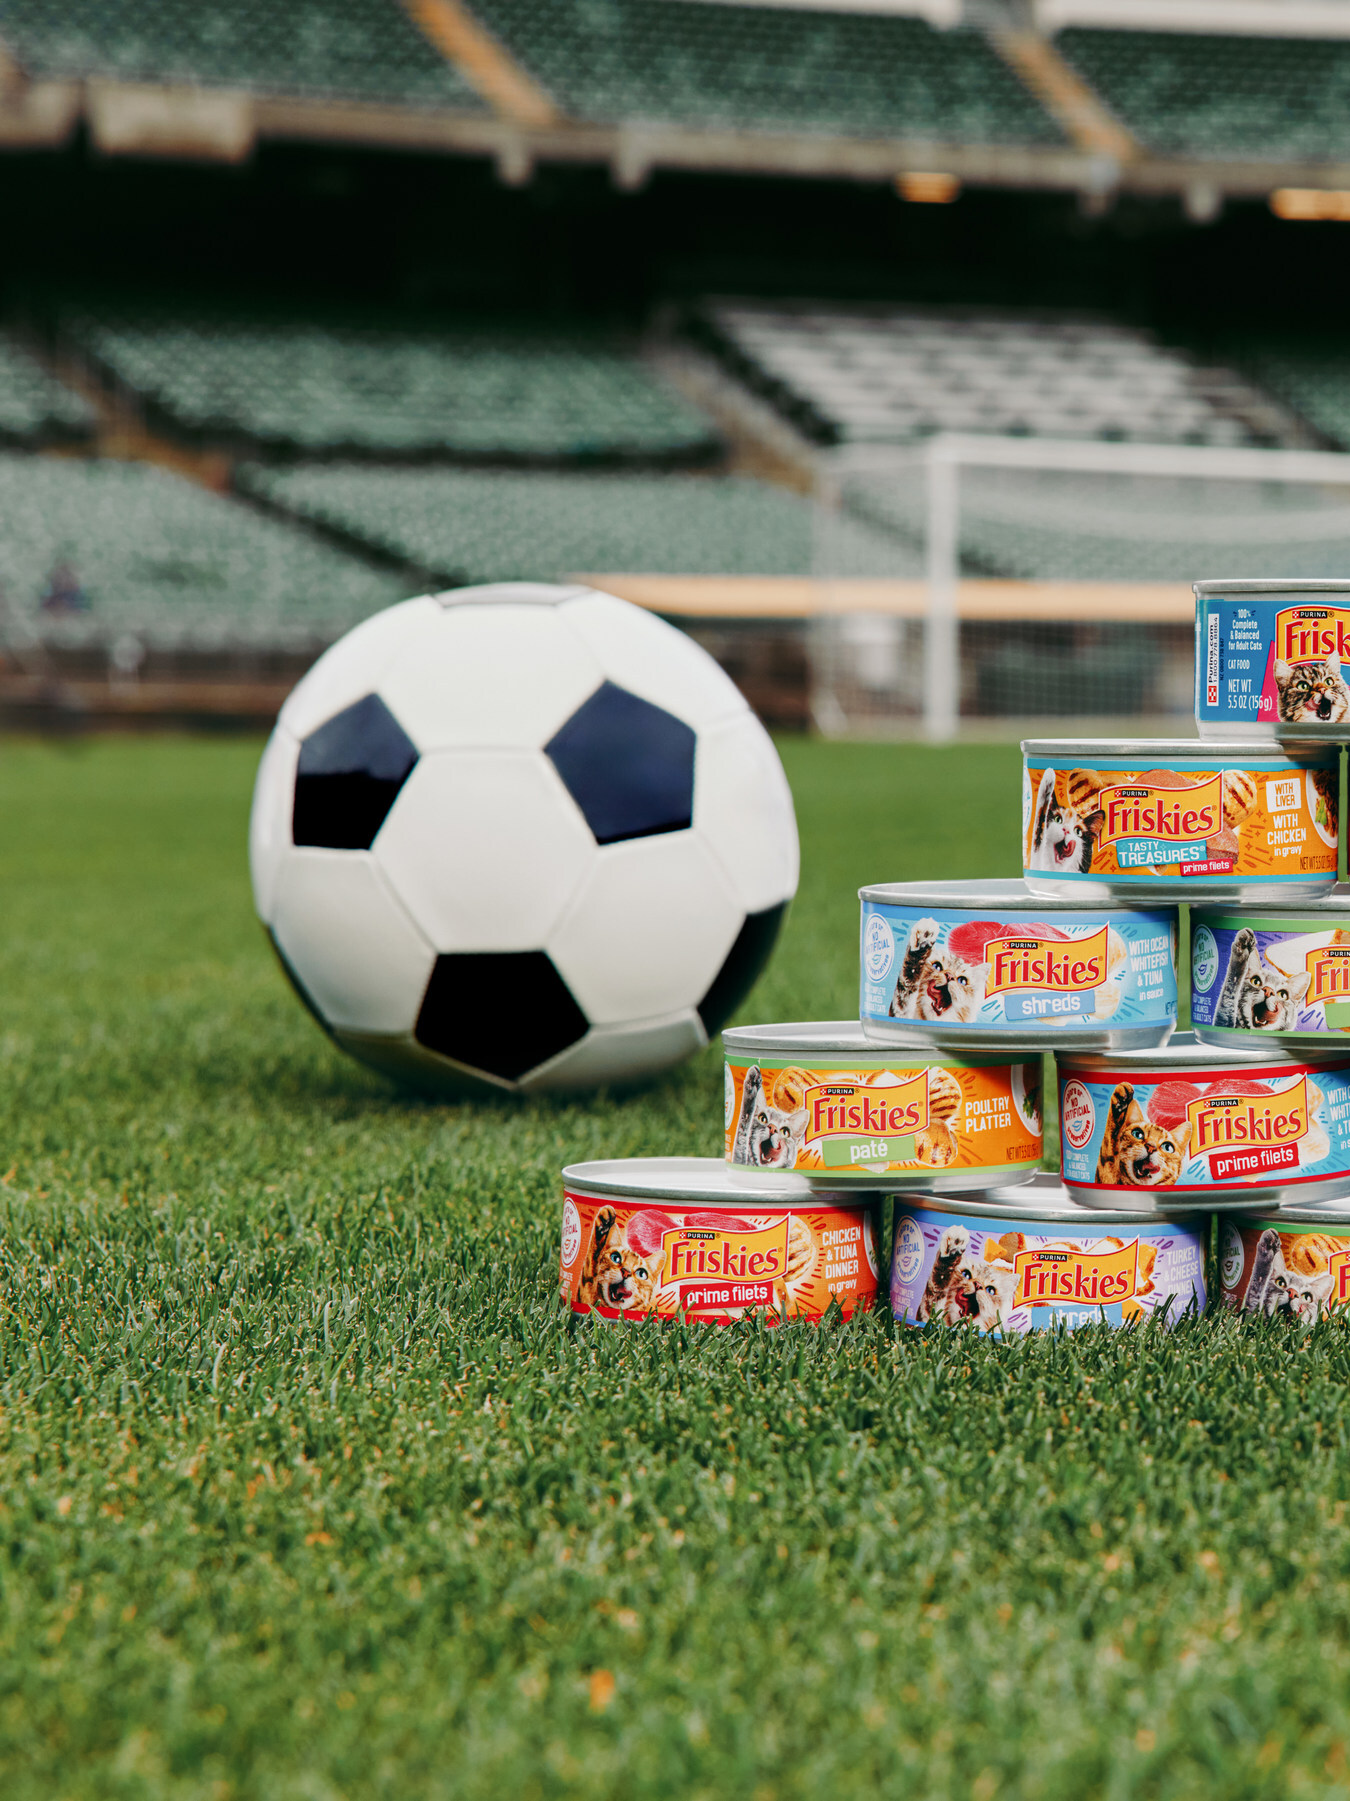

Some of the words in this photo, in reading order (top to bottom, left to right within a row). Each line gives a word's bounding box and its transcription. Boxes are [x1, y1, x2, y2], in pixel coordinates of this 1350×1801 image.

[1232, 620, 1258, 631] Complete
[1234, 630, 1260, 640] Balanced
[1236, 640, 1250, 650] Adult
[1250, 641, 1262, 651] Cats
[1228, 660, 1237, 670] CAT
[1237, 660, 1250, 670] FOOD
[1228, 679, 1240, 692] NET
[1240, 679, 1252, 692] WT
[1228, 695, 1238, 709] 5.5
[1238, 695, 1248, 709] OZ
[1275, 782, 1294, 794] WITH
[1276, 794, 1296, 808] LIVER
[1108, 799, 1213, 836] Friskies
[1273, 814, 1298, 828] WITH
[1267, 828, 1306, 845] CHICKEN
[1128, 842, 1158, 851] TASTY
[1274, 846, 1282, 856] in
[1282, 845, 1302, 858] gravy
[1183, 863, 1207, 875] prime
[1208, 860, 1230, 870] filets
[1128, 939, 1150, 956] WITH
[1150, 935, 1168, 952] OCEAN
[994, 950, 1100, 987] Friskies
[1130, 952, 1168, 972] WHITEFISH
[1137, 974, 1143, 986] &
[1143, 970, 1163, 986] TUNA
[1022, 994, 1080, 1014] shreds
[1327, 1086, 1347, 1105] WITH
[814, 1096, 920, 1134] Friskies
[966, 1096, 1010, 1116] POULTRY
[966, 1112, 1012, 1134] PLATTER
[1197, 1107, 1302, 1147] Friskies
[1338, 1123, 1343, 1136] &
[850, 1140, 888, 1164] paté
[1340, 1141, 1347, 1150] in
[1216, 1158, 1259, 1178] prime
[1260, 1148, 1294, 1166] filets
[686, 1232, 714, 1240] PURINA
[822, 1226, 860, 1246] CHICKEN
[670, 1241, 779, 1278] Friskies
[826, 1250, 833, 1261] &
[834, 1243, 858, 1261] TUNA
[1039, 1254, 1066, 1262] PURINA
[1167, 1245, 1196, 1266] TURKEY
[826, 1260, 858, 1279] DINNER
[1170, 1260, 1198, 1280] CHEESE
[828, 1283, 836, 1292] in
[836, 1278, 857, 1293] gravy
[1022, 1263, 1129, 1300] Friskies
[686, 1288, 730, 1307] prime
[732, 1284, 768, 1302] filets
